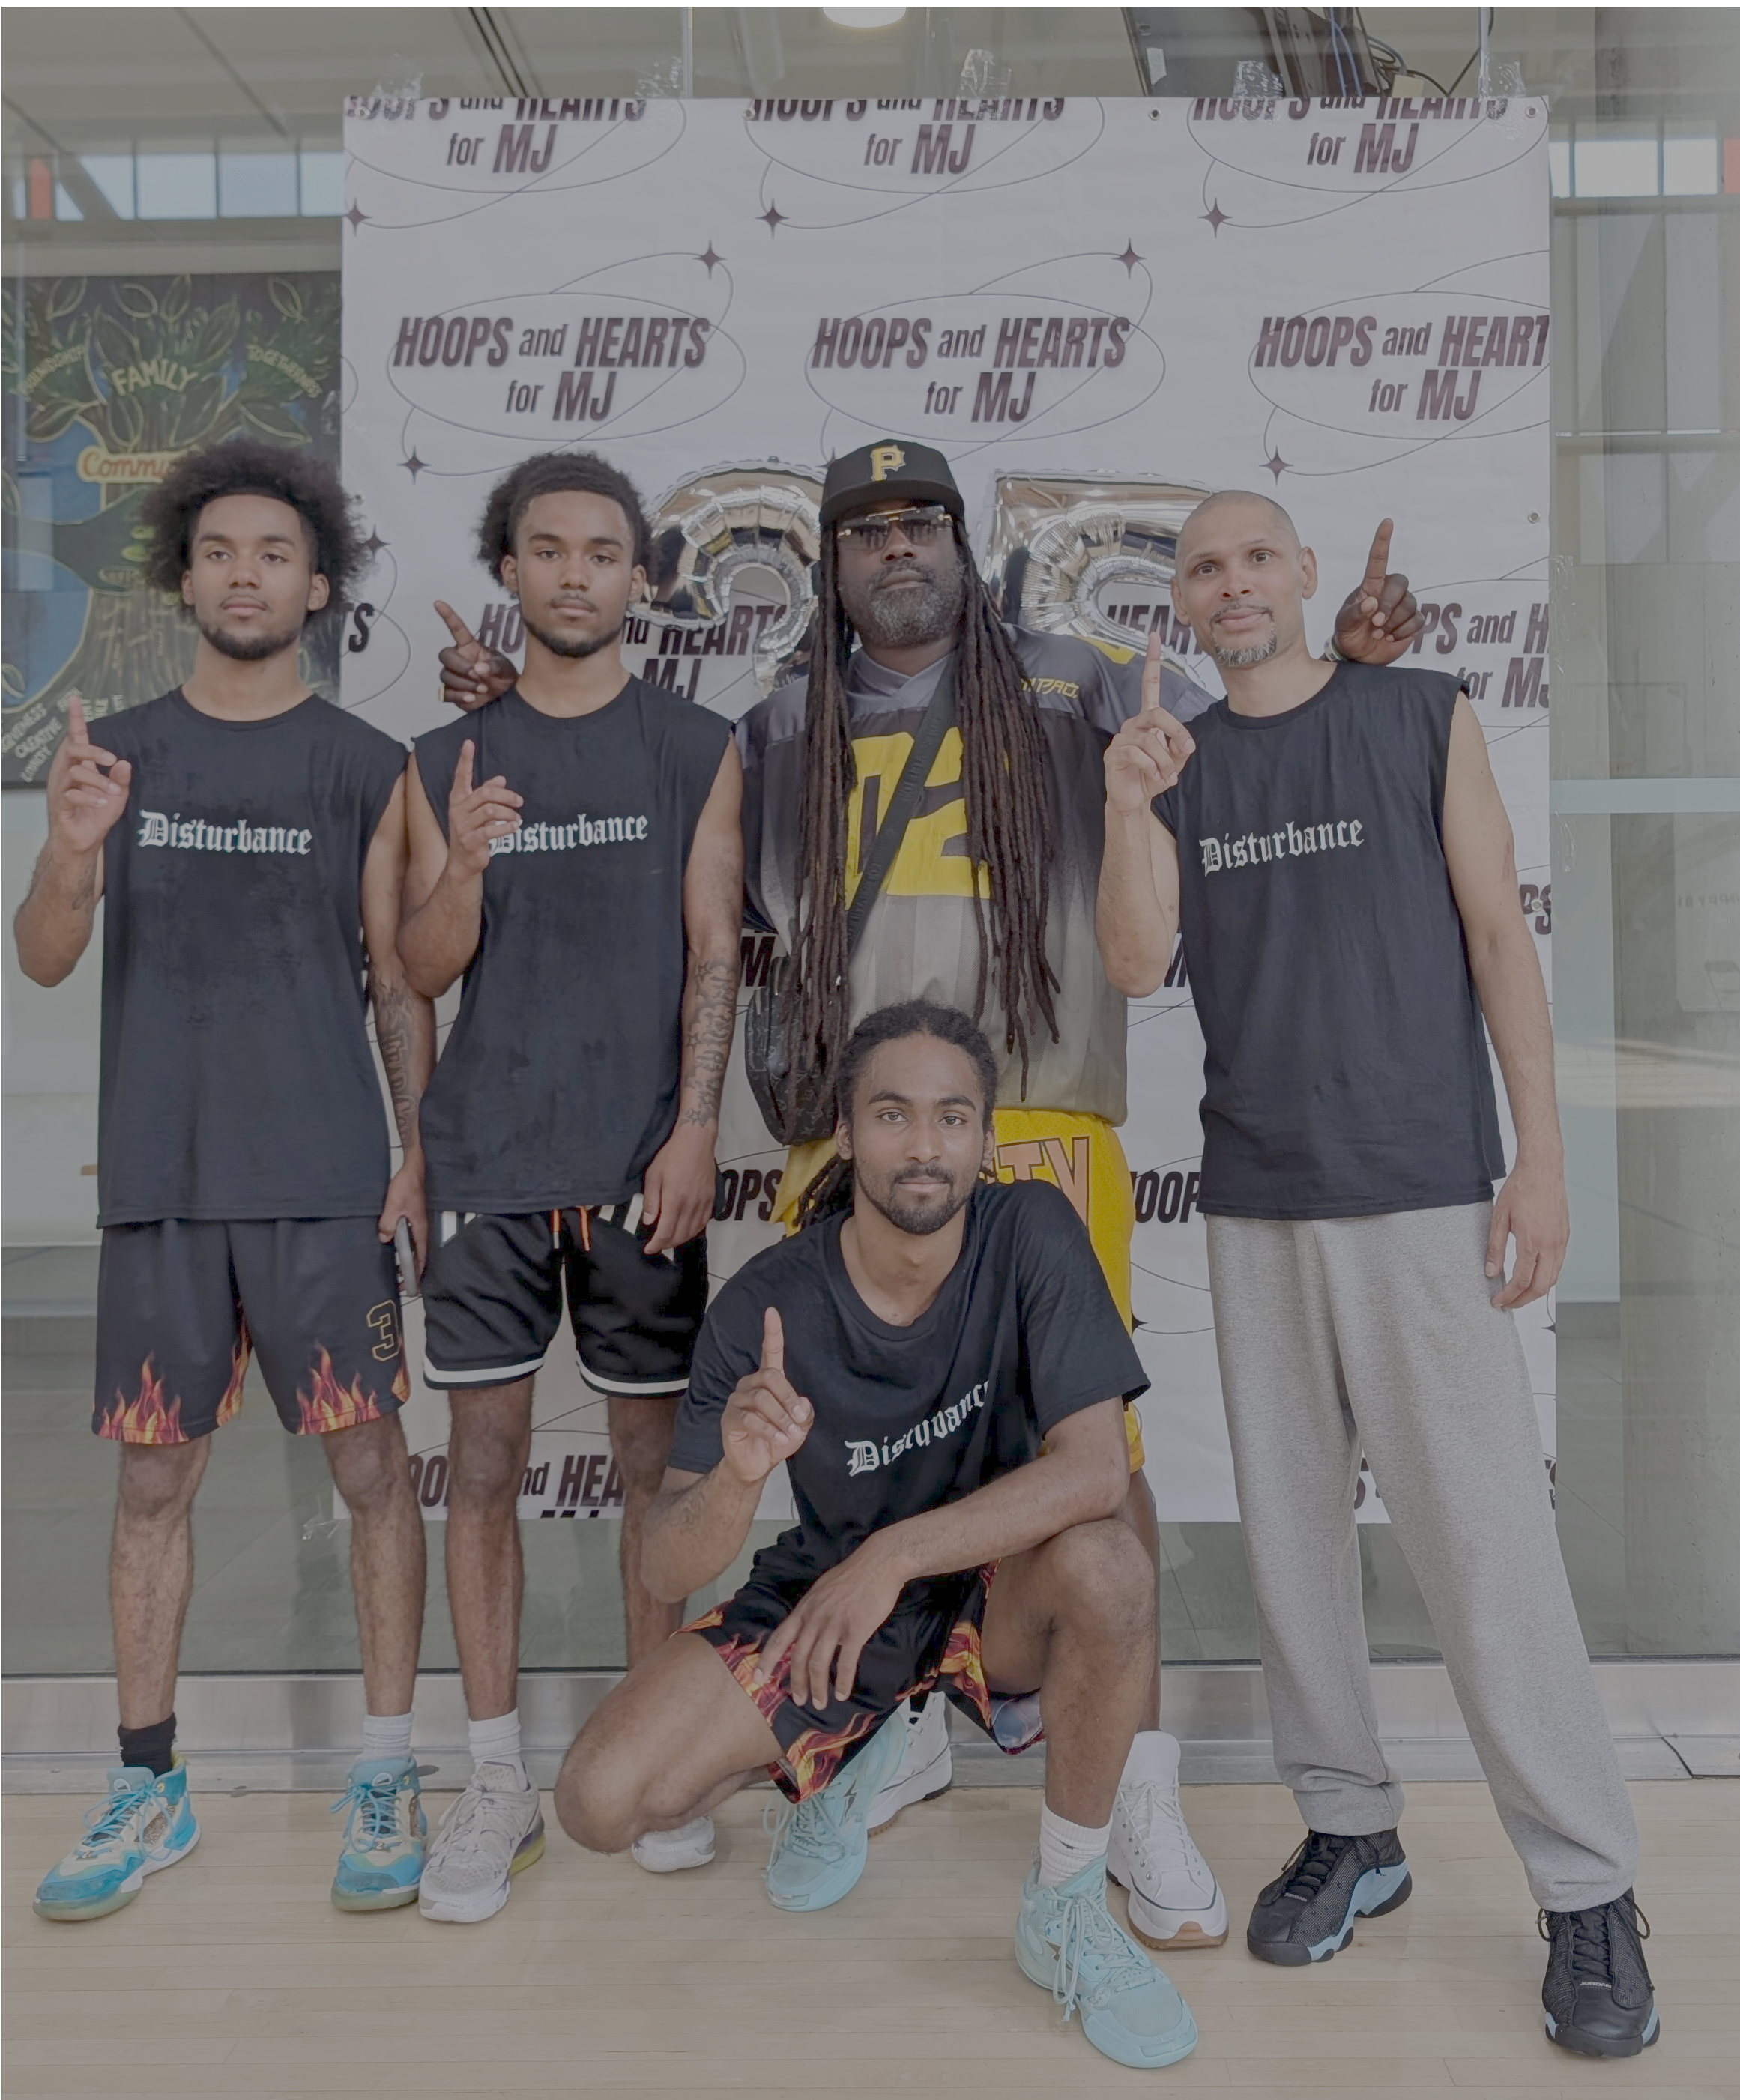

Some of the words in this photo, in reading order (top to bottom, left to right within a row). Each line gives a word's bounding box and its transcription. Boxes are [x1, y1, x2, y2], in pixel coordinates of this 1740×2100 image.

[447, 133, 486, 166] for
[492, 124, 557, 173] MJ
[864, 133, 903, 166] for
[910, 124, 975, 174] MJ
[1307, 132, 1347, 165] for
[1353, 123, 1419, 173] MJ
[393, 316, 513, 367] HOOPS
[519, 324, 567, 357] and
[574, 317, 711, 367] HEARTS
[812, 317, 931, 368] HOOPS
[937, 324, 987, 357] and
[993, 316, 1134, 368] HEARTS
[1254, 315, 1376, 367] HOOPS
[1382, 323, 1432, 356] and
[110, 358, 199, 396] FAMILY
[506, 380, 543, 412] for
[552, 371, 617, 421] MJ
[925, 381, 963, 414] for
[971, 371, 1036, 423] MJ
[1369, 379, 1408, 411] for
[1416, 369, 1481, 420] MJ
[82, 453, 169, 479] Commu
[870, 444, 906, 482] P
[1466, 610, 1518, 644] and
[138, 809, 312, 856] Disturbance
[1199, 818, 1365, 877] Disturbance
[365, 1298, 400, 1361] 3
